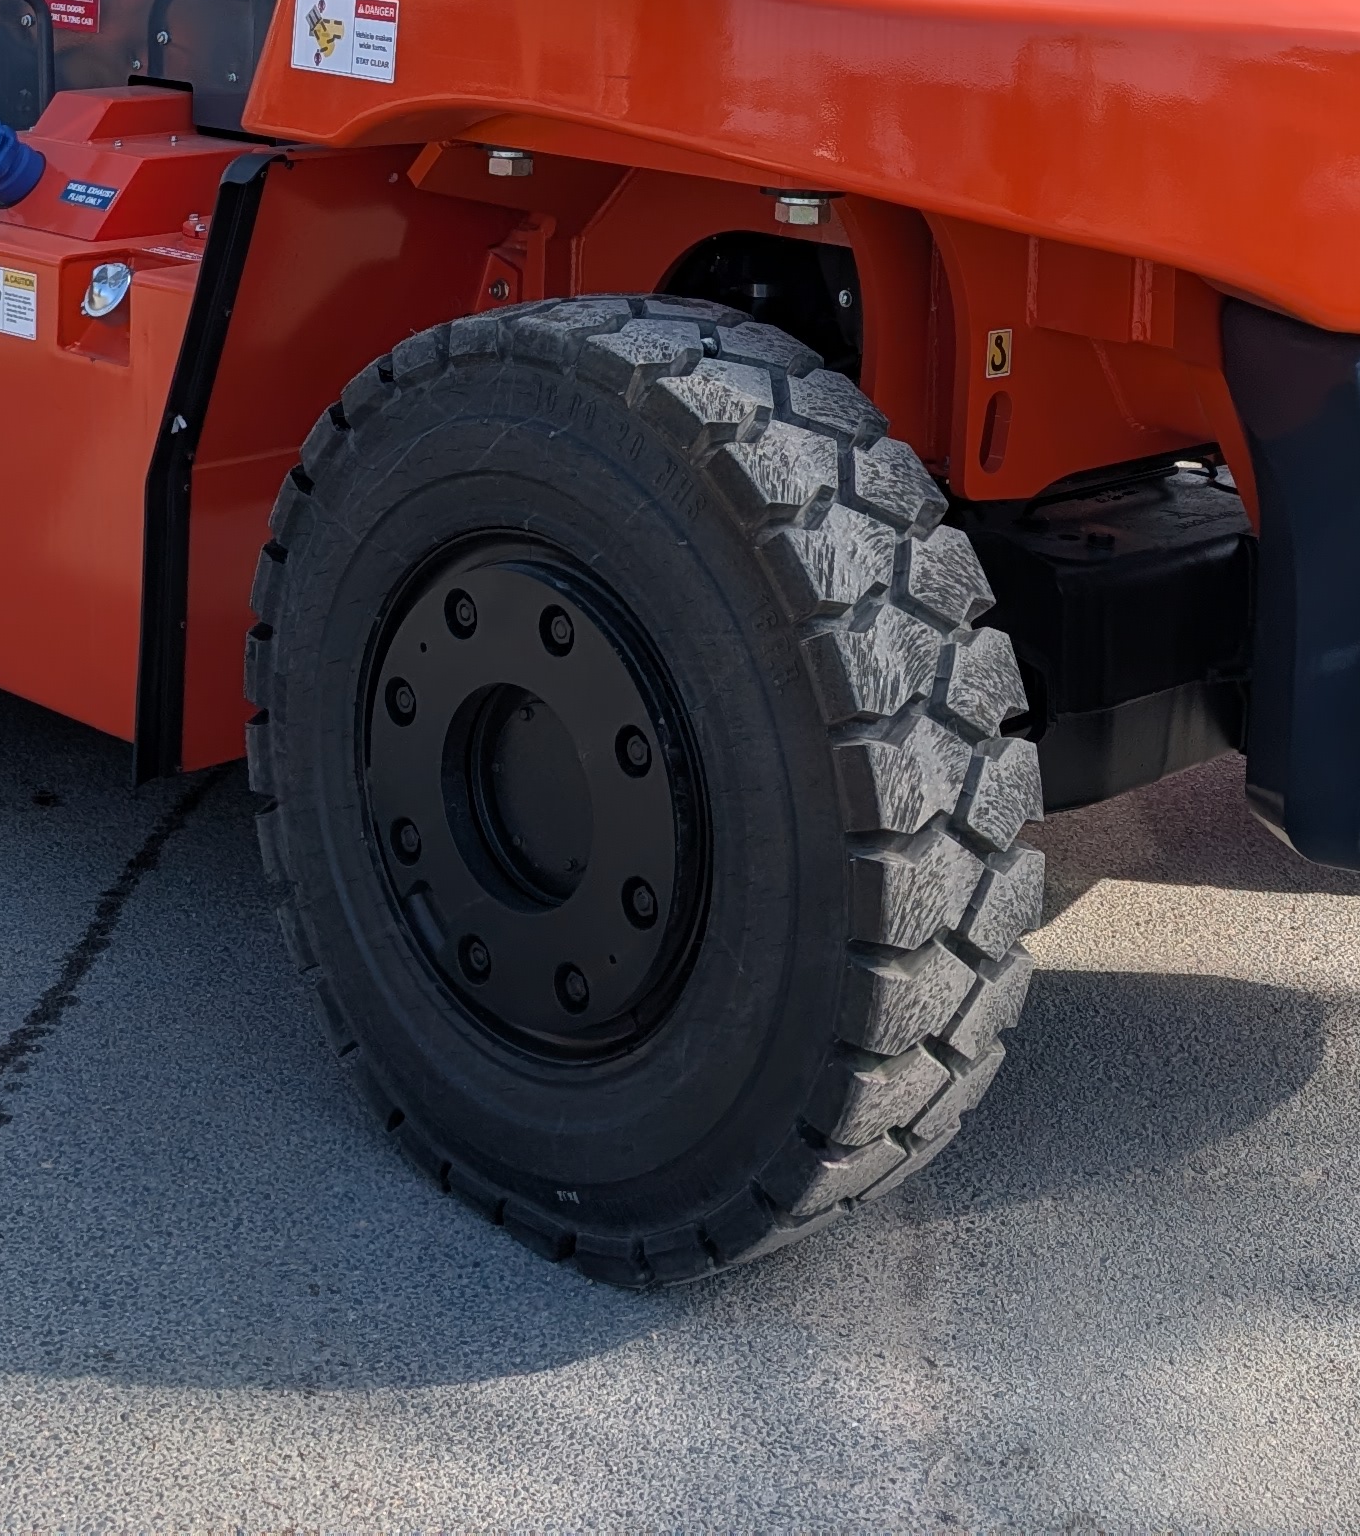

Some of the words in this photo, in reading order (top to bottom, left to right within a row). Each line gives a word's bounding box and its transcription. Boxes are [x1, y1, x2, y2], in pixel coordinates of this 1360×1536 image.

[364, 4, 395, 18] DANGER
[355, 30, 375, 40] Vehicle
[370, 59, 390, 69] CLEAR
[67, 182, 86, 193] DIESEL
[67, 192, 85, 203] FLUID
[85, 195, 102, 206] ONLY
